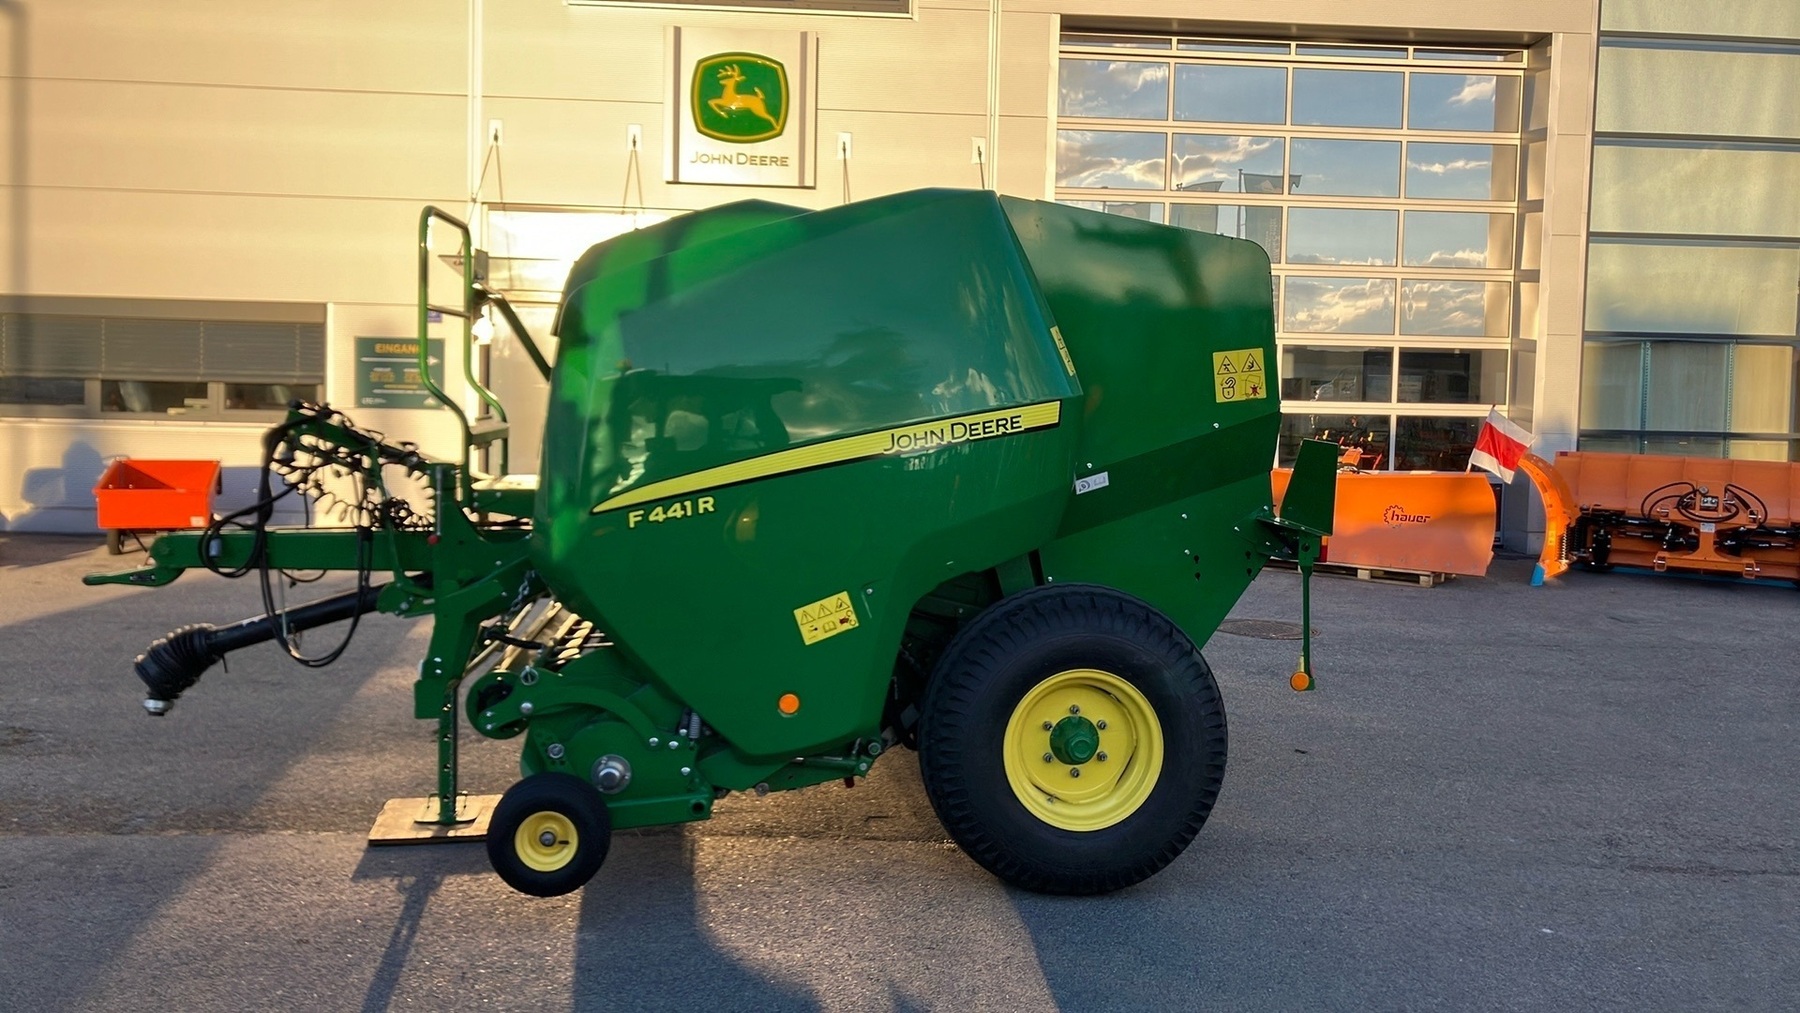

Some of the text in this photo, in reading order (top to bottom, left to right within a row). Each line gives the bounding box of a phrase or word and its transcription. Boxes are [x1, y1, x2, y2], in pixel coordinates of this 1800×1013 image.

[690, 151, 790, 167] JOHN DEERE
[883, 414, 1024, 453] JOHN DEERE
[628, 496, 715, 529] F 441 R
[1390, 510, 1431, 523] hauer
